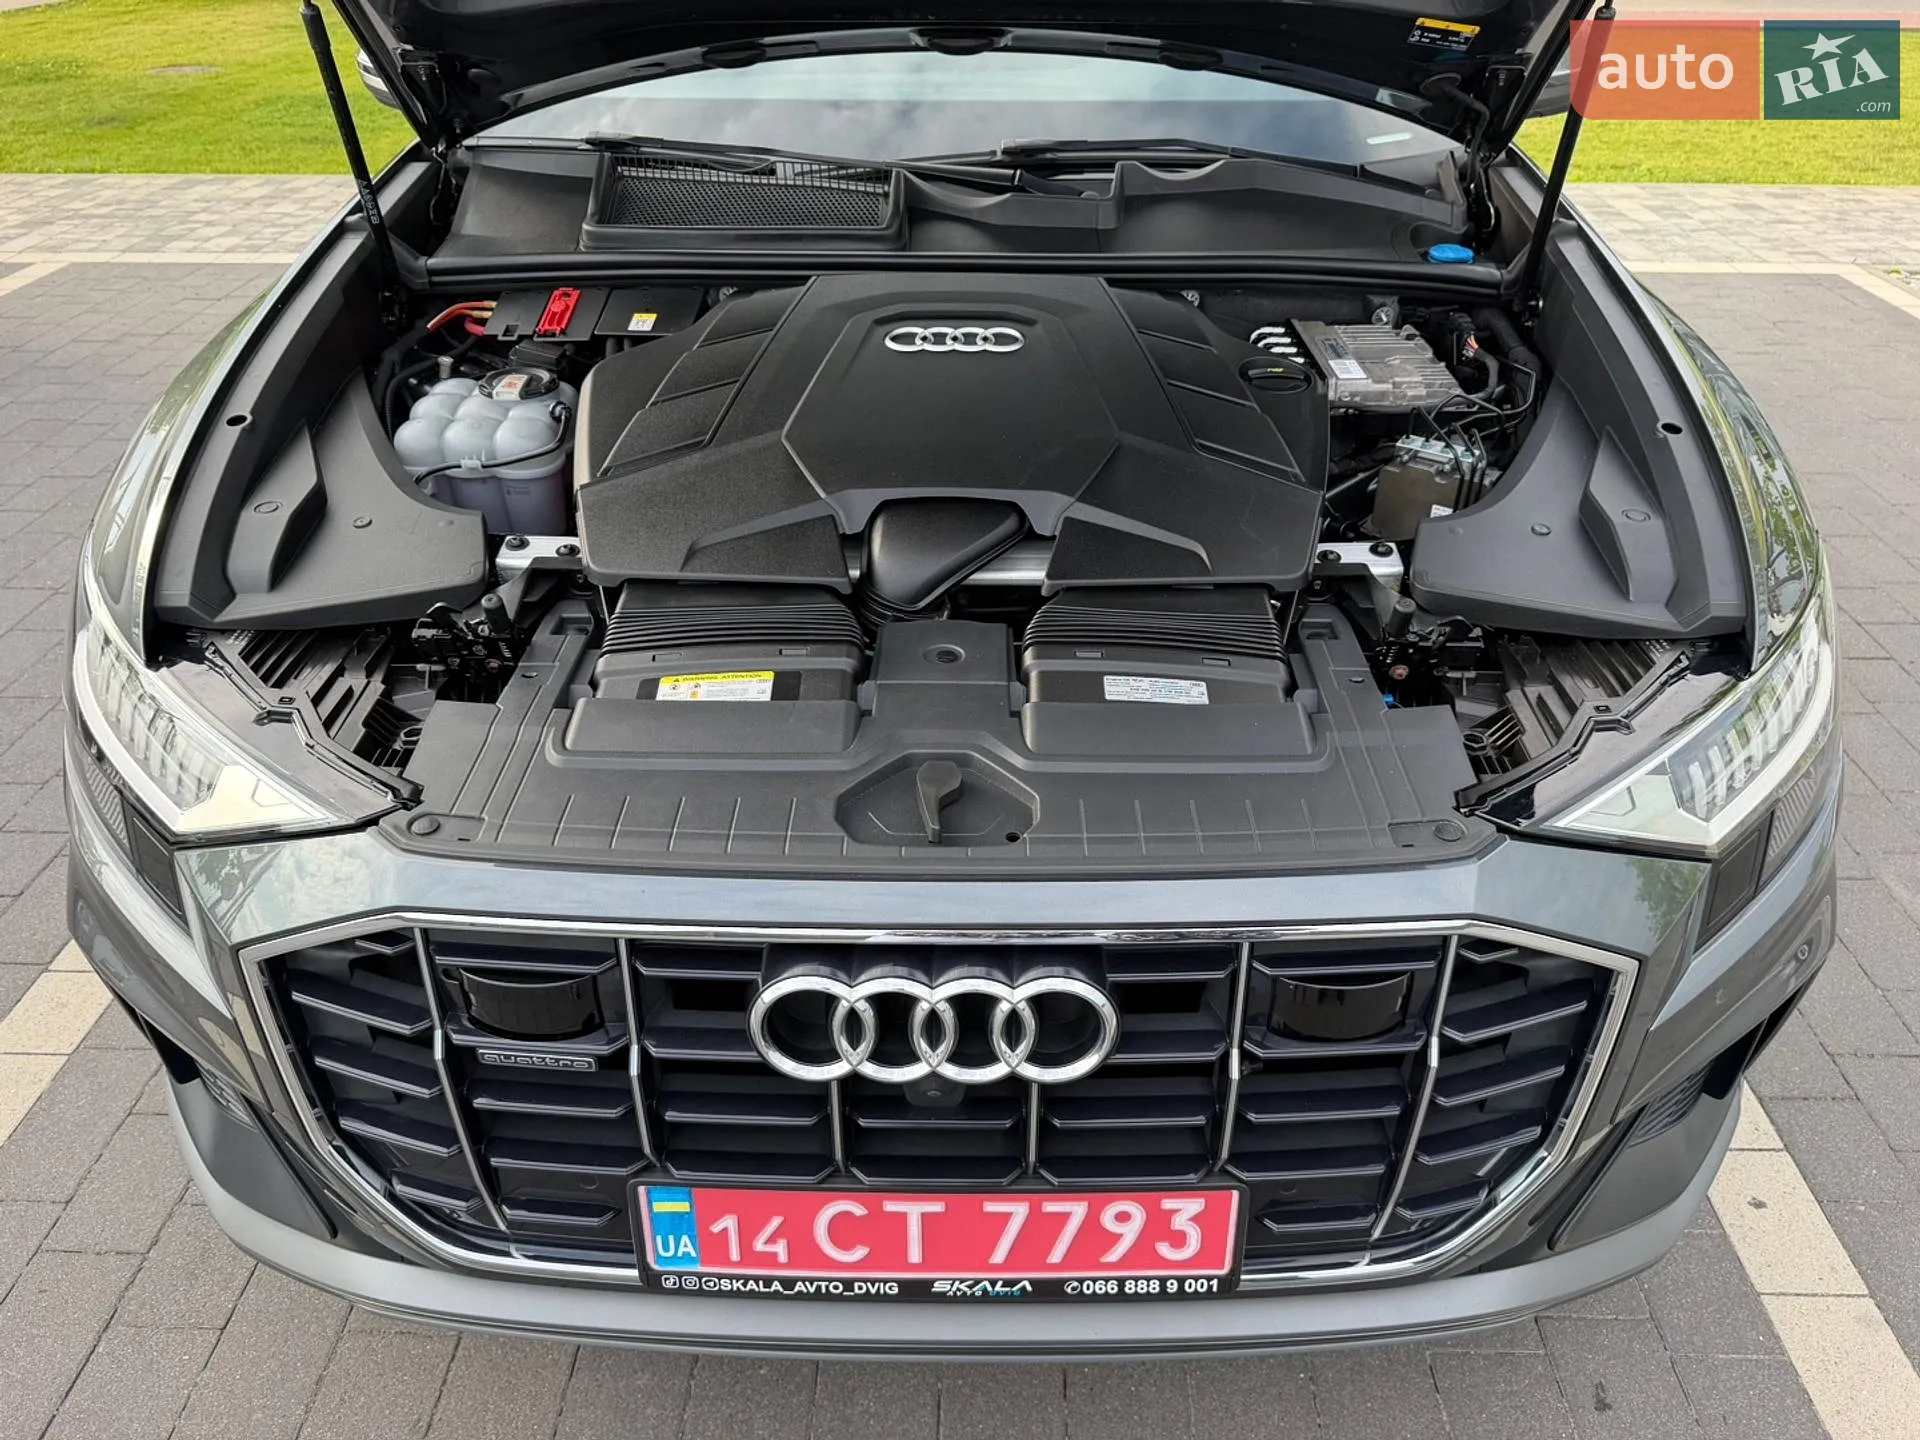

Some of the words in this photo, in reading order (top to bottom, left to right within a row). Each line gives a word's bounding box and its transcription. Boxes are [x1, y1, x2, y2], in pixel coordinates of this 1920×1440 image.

[483, 1054, 588, 1068] quattro
[709, 1213, 790, 1264] 14
[812, 1200, 946, 1264] CT
[982, 1198, 1206, 1264] 7793
[655, 1234, 697, 1258] UA
[720, 1279, 899, 1295] SKALA_AVTO_DVIG
[931, 1279, 1033, 1292] SKALA
[1082, 1280, 1119, 1294] 066
[1124, 1279, 1161, 1294] 888
[1166, 1278, 1178, 1293] 9
[1184, 1278, 1219, 1293] 001
